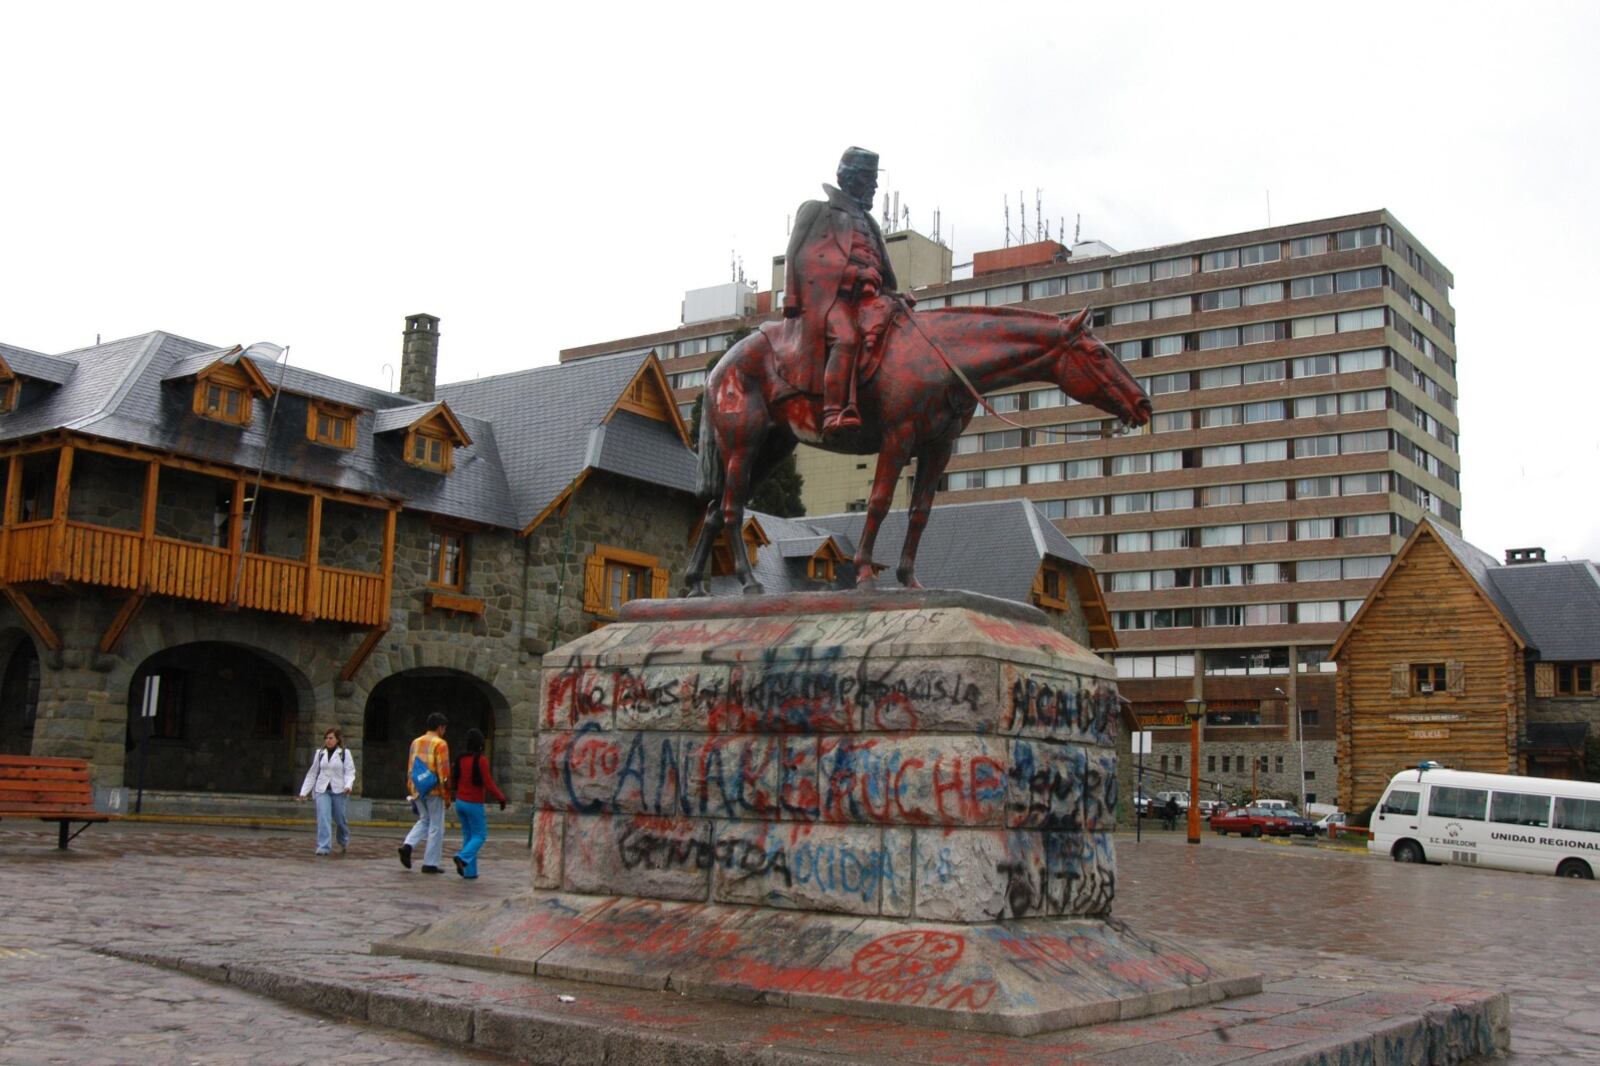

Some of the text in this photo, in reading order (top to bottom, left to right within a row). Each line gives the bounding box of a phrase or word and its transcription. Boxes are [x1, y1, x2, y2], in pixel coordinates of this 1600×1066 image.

[1442, 838, 1477, 848] BARILOCHE
[1491, 832, 1600, 850] UNIDAD REGIONAL
